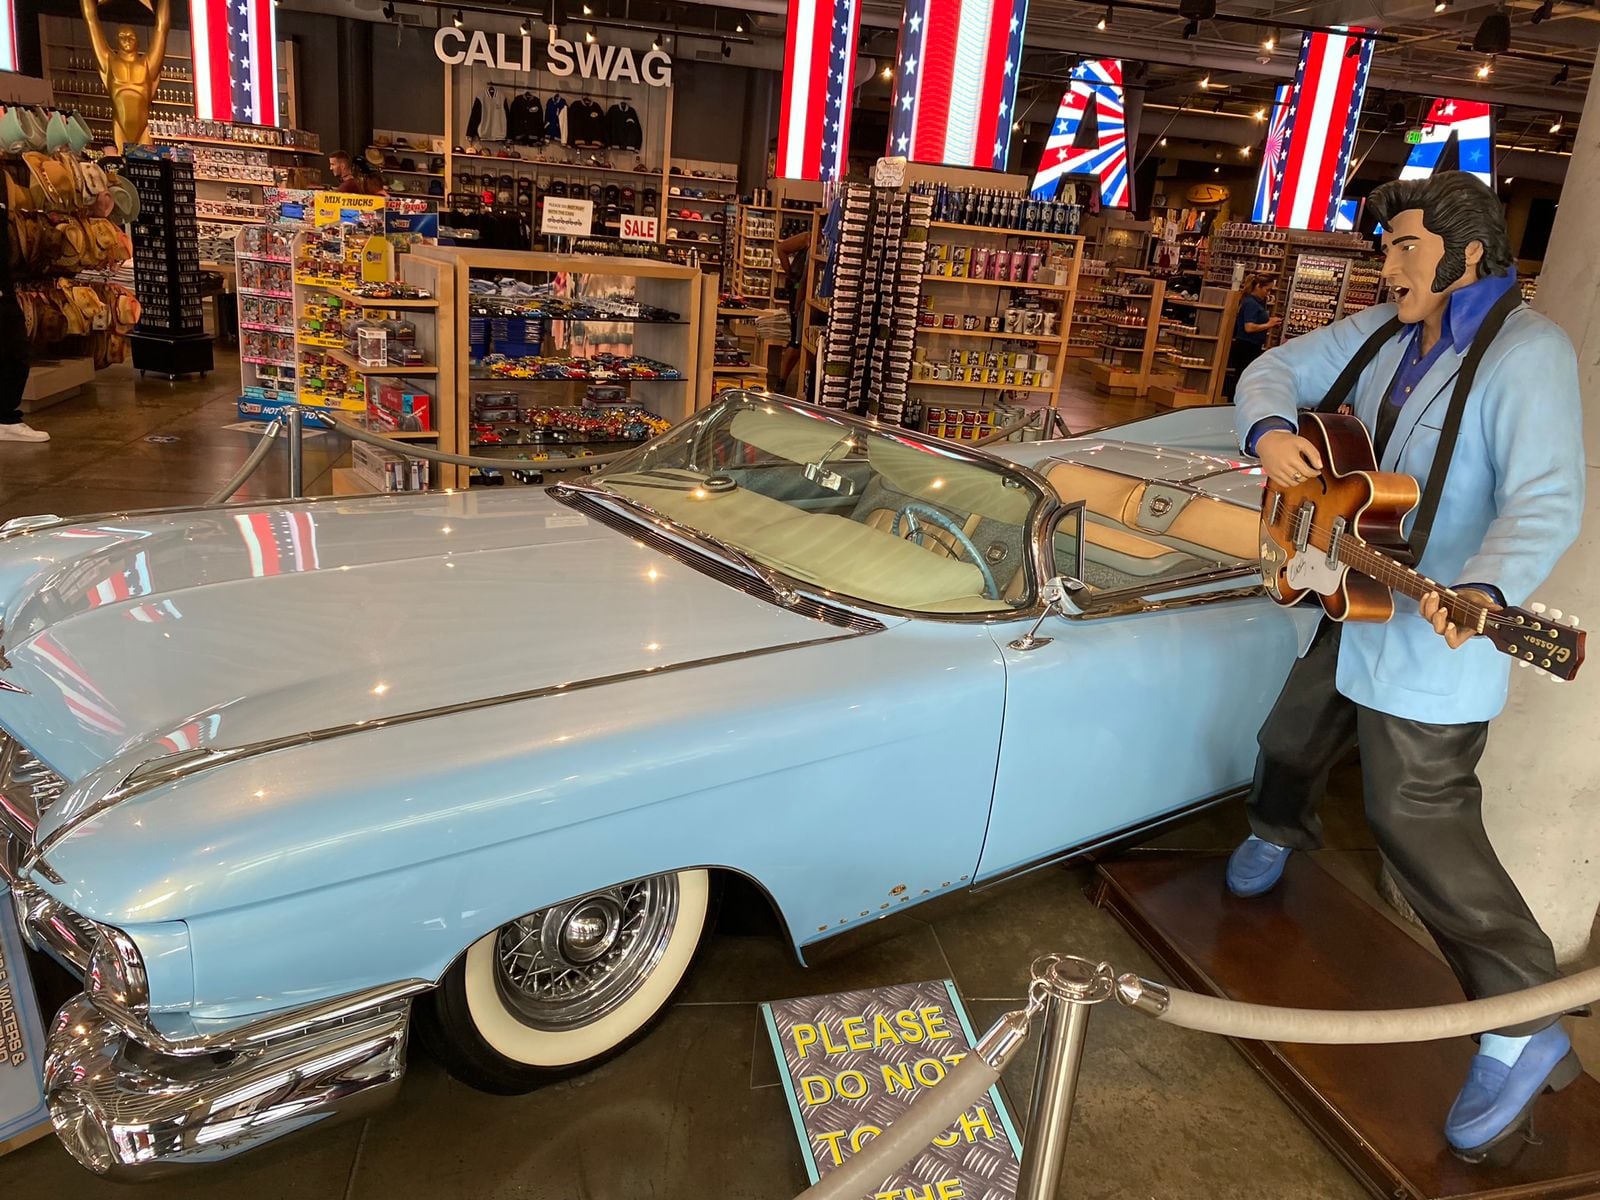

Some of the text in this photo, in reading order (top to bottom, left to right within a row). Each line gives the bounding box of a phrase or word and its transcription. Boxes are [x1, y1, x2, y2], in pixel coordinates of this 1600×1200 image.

[434, 26, 672, 87] CALI SWAG
[324, 195, 374, 207] MIX TRUCKS
[624, 219, 655, 238] SALE
[262, 406, 279, 415] HOT
[791, 1006, 952, 1060] PLEASE
[800, 1069, 869, 1107] DO
